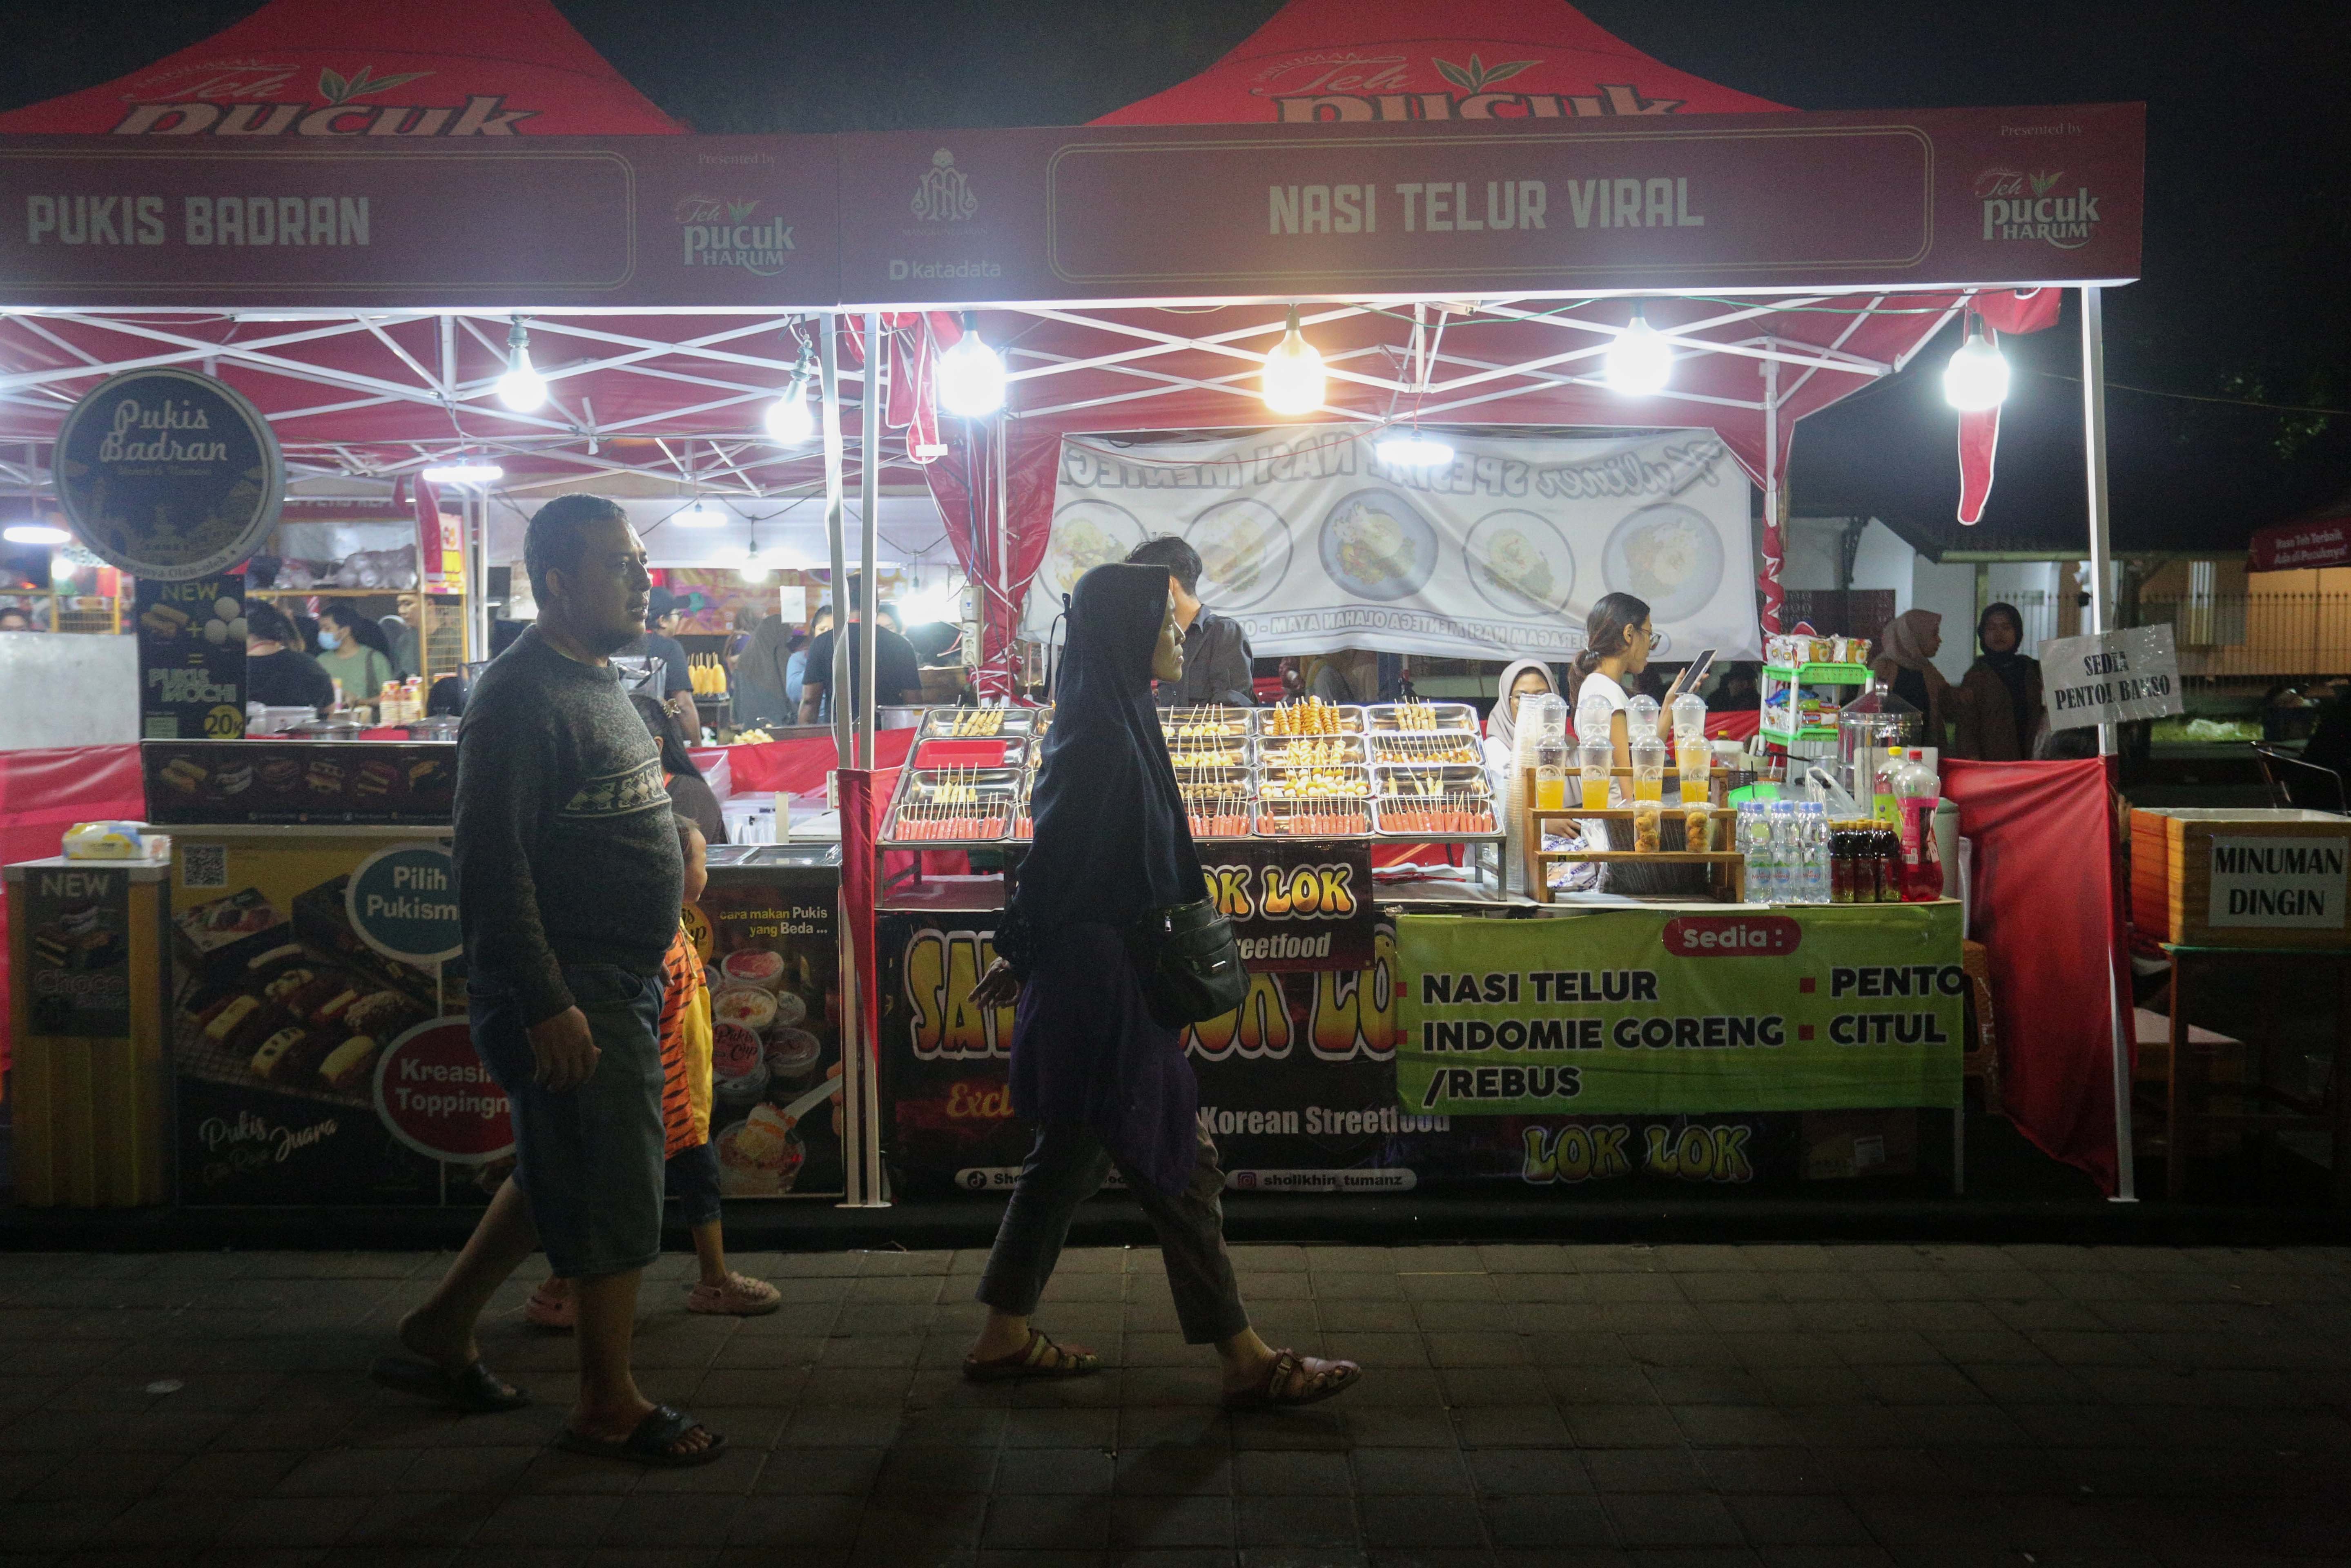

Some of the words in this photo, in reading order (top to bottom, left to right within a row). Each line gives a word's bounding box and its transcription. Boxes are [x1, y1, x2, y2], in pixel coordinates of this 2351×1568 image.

[1249, 55, 1413, 96] Teh
[2001, 124, 2063, 136] Presented
[2066, 123, 2084, 137] by
[699, 154, 758, 165] Presented
[762, 154, 776, 169] by
[1975, 172, 2022, 198] Teh
[675, 198, 720, 224] Teh
[1270, 185, 1375, 234] NASI
[1396, 180, 1547, 232] TELUR
[1567, 177, 1704, 228] VIRAL
[1982, 188, 2100, 241] pucuk
[27, 196, 164, 246] PUKIS
[184, 196, 370, 246] BADRAN
[2003, 222, 2088, 240] HARUM
[683, 216, 796, 265] pucuk
[703, 250, 784, 266] HARUM
[912, 260, 1001, 278] katadata
[114, 399, 208, 433] Pukis
[99, 431, 227, 463] Badran
[163, 582, 219, 601] NEW
[2084, 651, 2129, 677] SEDIA
[2215, 847, 2344, 875] MINUMAN
[42, 873, 109, 897] NEW
[393, 866, 448, 892] Pilih
[1260, 864, 1357, 921] LOK
[367, 894, 458, 921] Pukism
[720, 908, 747, 920] cara
[750, 908, 790, 919] makan
[792, 906, 828, 919] Pukis
[2228, 888, 2326, 916] DINGIN
[749, 924, 778, 938] yang
[780, 922, 813, 935] Beda
[1422, 972, 1520, 1004] NASI
[1528, 969, 1658, 1003] TELUR
[1422, 1019, 1604, 1053] INDOMIE
[1612, 1015, 1785, 1050] GORENG
[1828, 1012, 1948, 1047] CITUL
[401, 1058, 491, 1084] Kreasi
[1422, 1065, 1582, 1109] /REBUS
[946, 1084, 1015, 1120] Excl
[199, 1110, 267, 1152] Pukis
[1201, 1106, 1299, 1135] Korean
[1306, 1106, 1450, 1135] Streetfood
[1522, 1124, 1631, 1184] LOK
[1642, 1124, 1754, 1184] LOK
